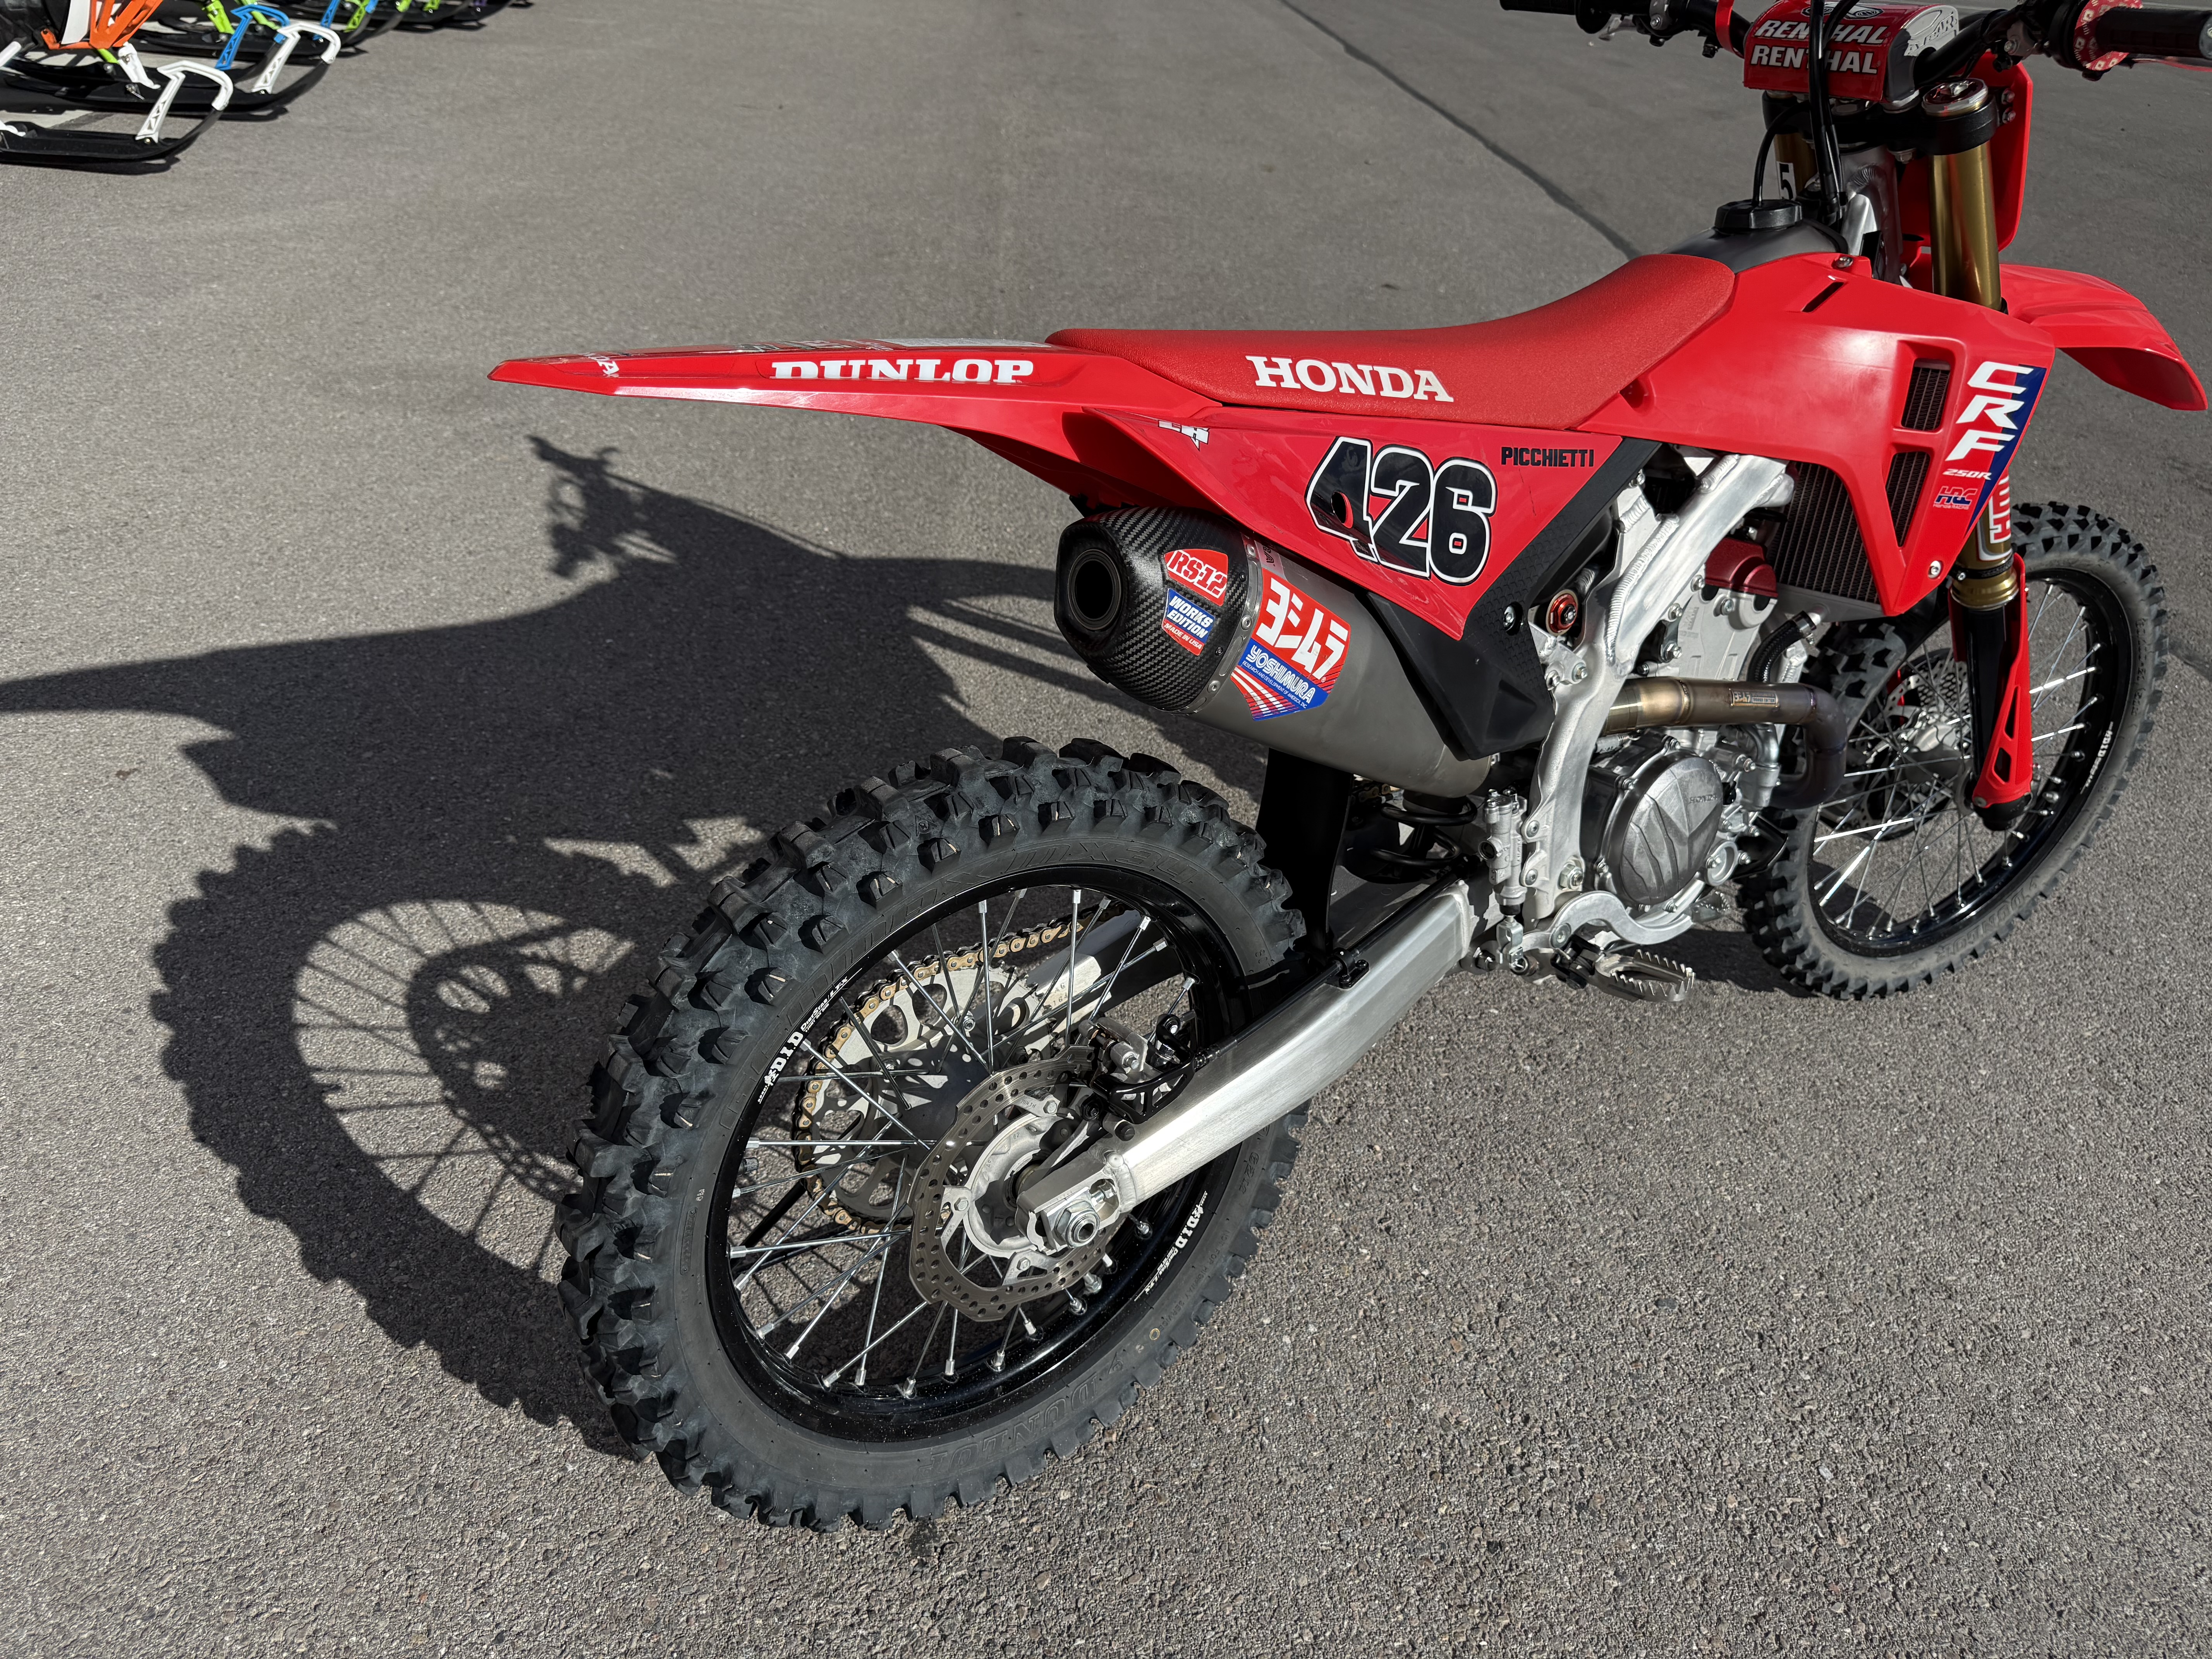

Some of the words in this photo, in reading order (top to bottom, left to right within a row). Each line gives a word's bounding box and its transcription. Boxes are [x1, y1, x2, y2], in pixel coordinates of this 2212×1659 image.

[1755, 20, 1889, 44] RENHAL
[1751, 45, 1877, 74] RENHAL
[771, 359, 1034, 383] DUNLOP
[1245, 355, 1454, 402] HONDA
[1945, 361, 2033, 461] CRF
[1501, 447, 1594, 467] PICCHIETTI
[1942, 469, 1992, 480] 250R
[1934, 486, 1978, 505] HRC
[1304, 436, 1498, 586] 426
[1166, 609, 1208, 638] EDITION
[1169, 595, 1213, 628] WORKS
[1164, 622, 1182, 638] MADE
[1182, 634, 1189, 642] IN
[1189, 638, 1203, 650] USA
[1246, 644, 1316, 704] YOSHIMURA
[912, 1372, 1097, 1482] DUNLOP
